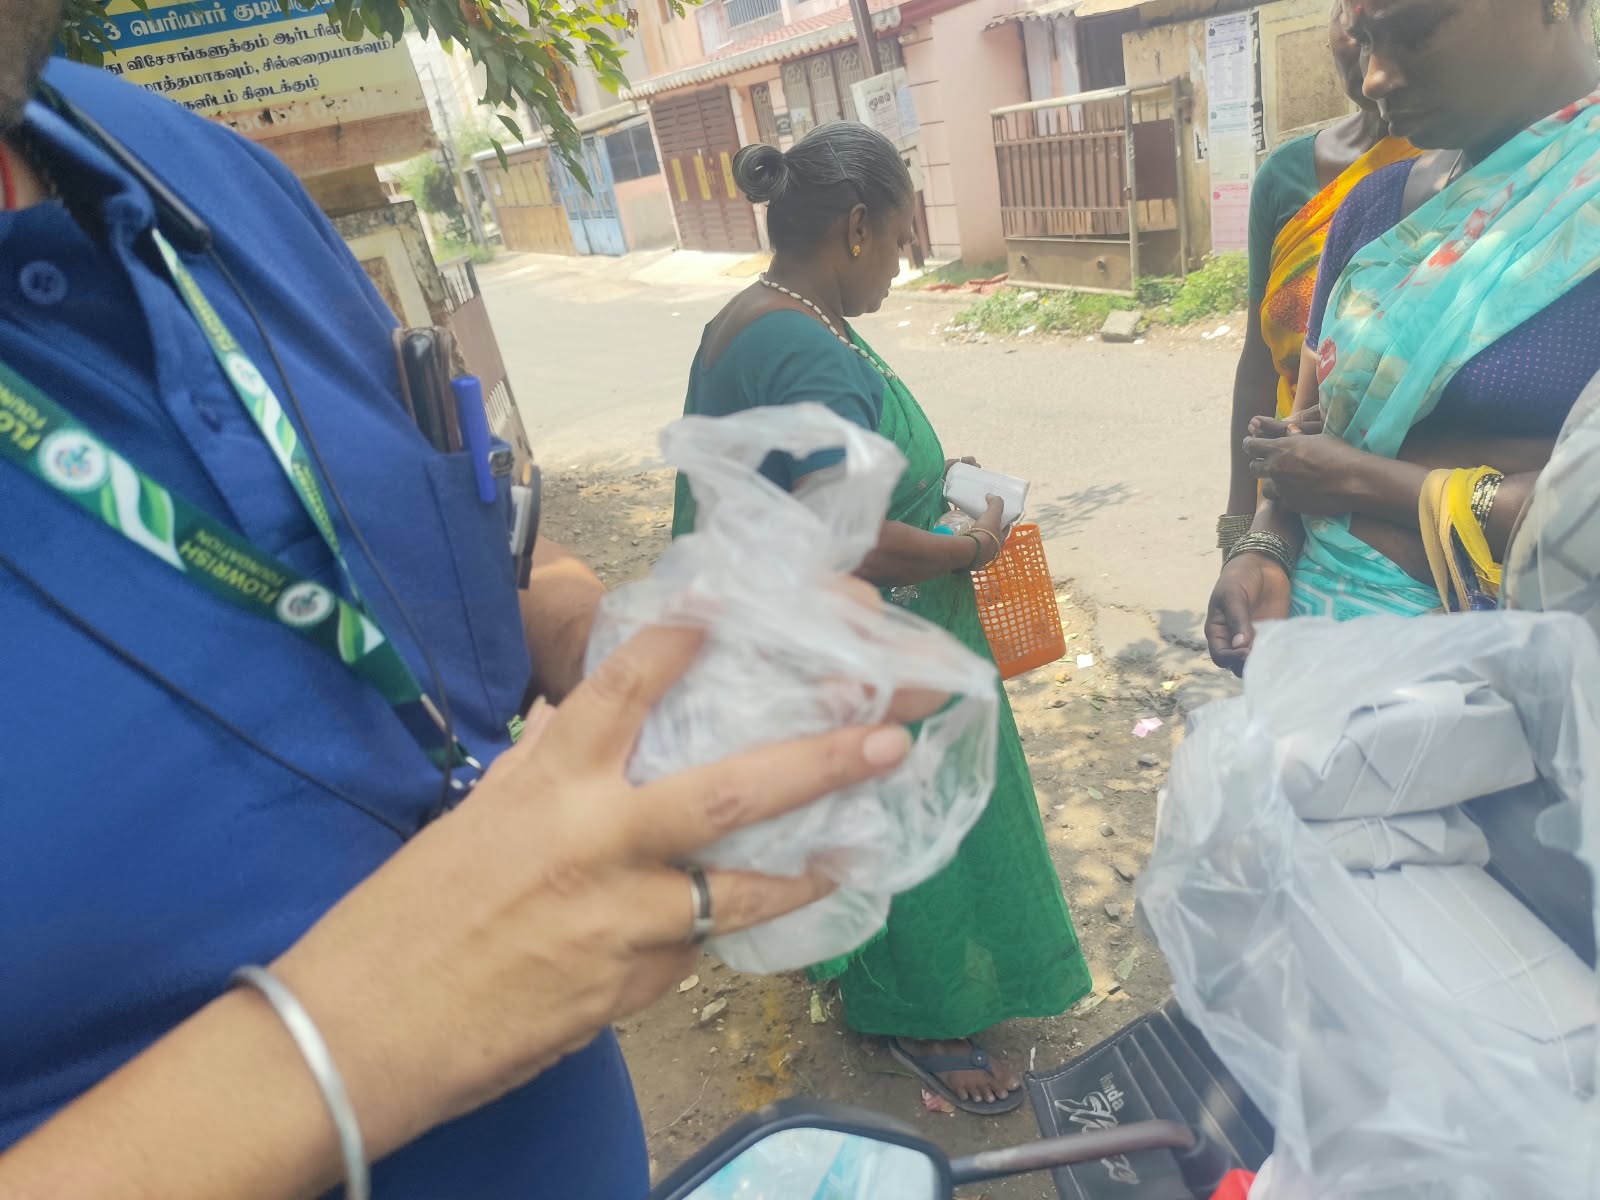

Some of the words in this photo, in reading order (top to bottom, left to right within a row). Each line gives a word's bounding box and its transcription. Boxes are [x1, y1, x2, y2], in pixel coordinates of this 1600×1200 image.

[129, 2, 226, 37] பெரியார்
[242, 73, 320, 101] கிடைக்கும்
[179, 541, 281, 604] FLOWRISH
